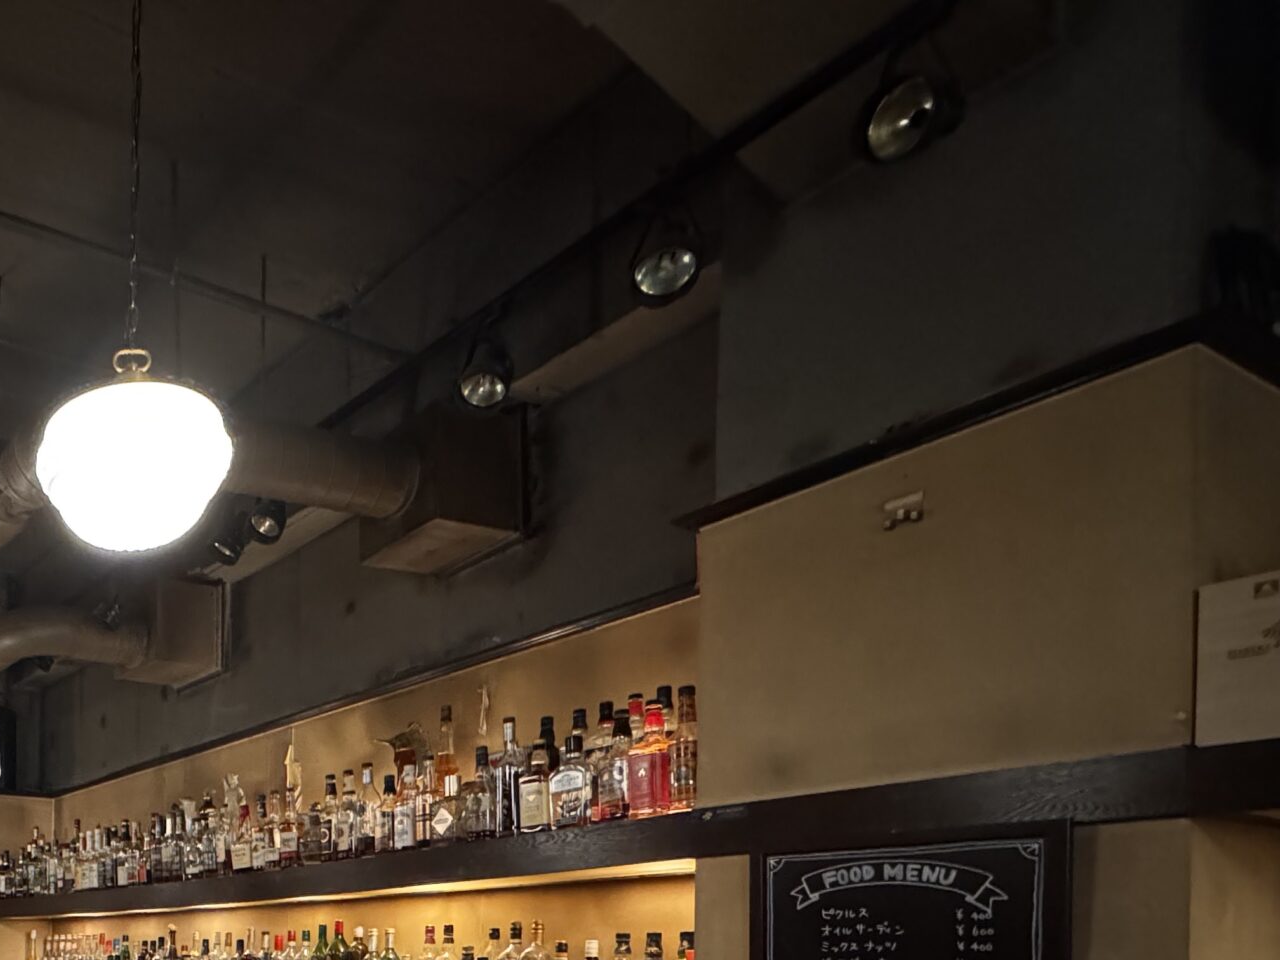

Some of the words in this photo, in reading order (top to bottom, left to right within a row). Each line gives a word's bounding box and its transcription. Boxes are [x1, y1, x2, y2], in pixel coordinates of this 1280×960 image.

[822, 865, 875, 889] FOOD
[883, 863, 958, 886] MENU
[821, 908, 869, 920] ピクルス
